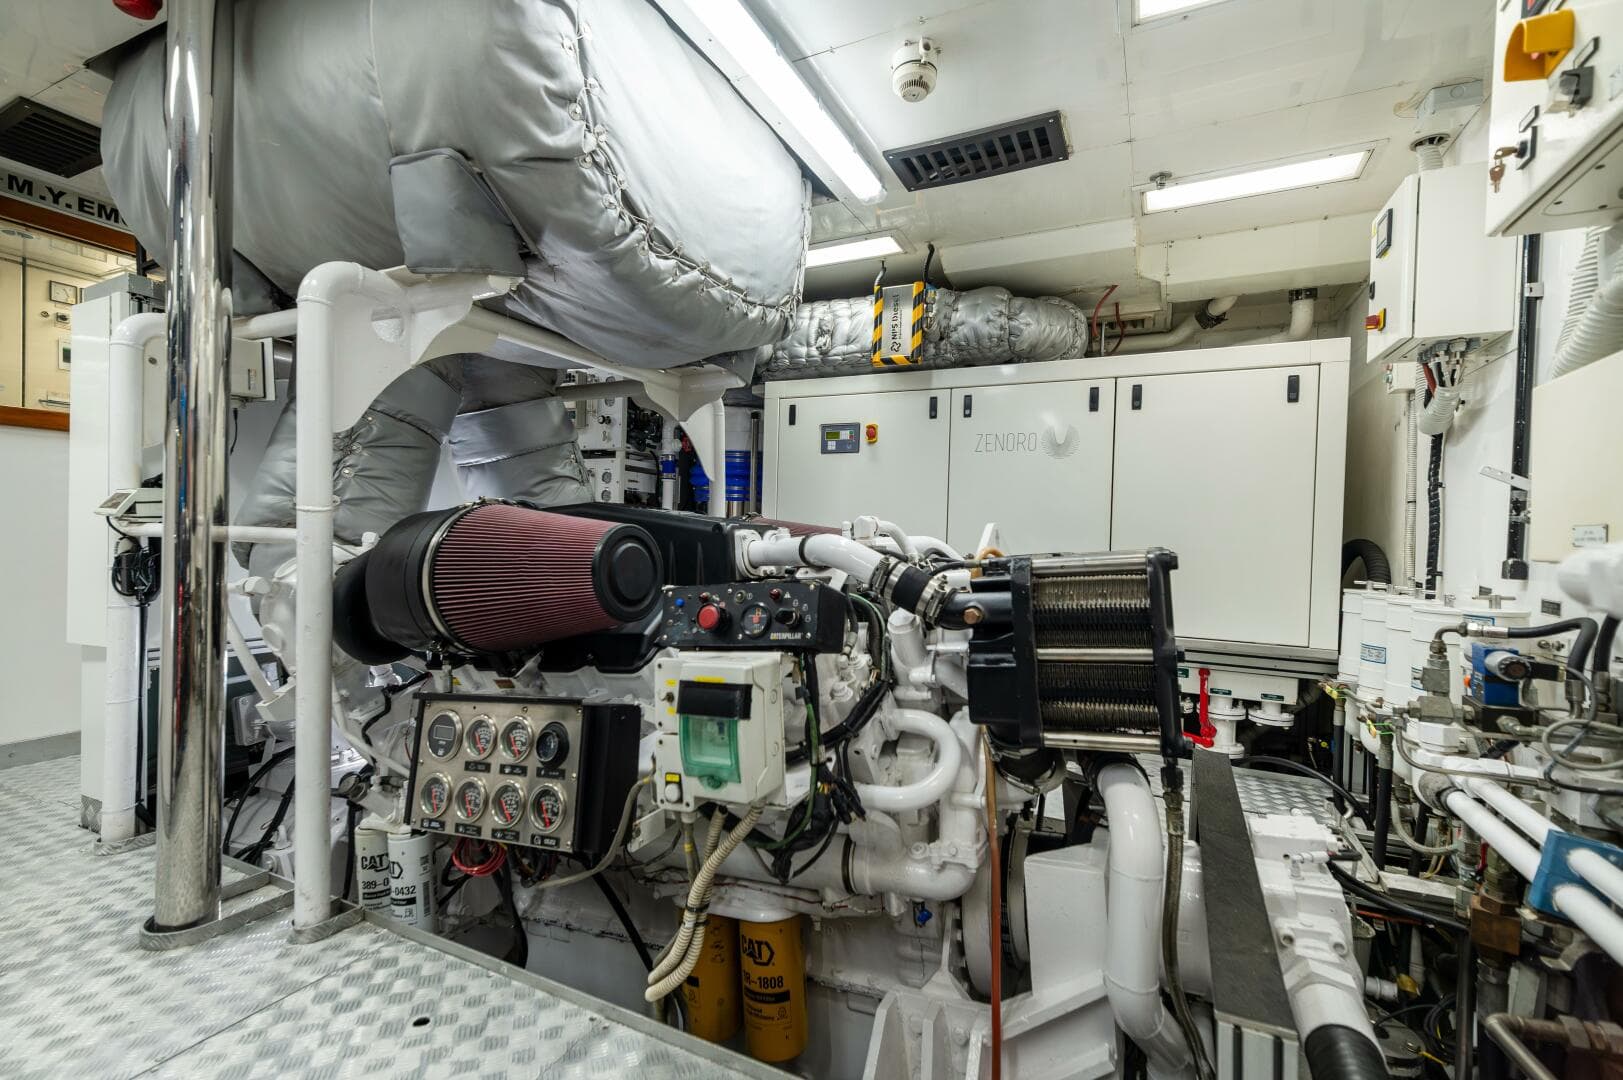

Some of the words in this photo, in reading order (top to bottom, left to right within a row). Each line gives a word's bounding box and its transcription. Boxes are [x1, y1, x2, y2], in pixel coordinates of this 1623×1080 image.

[891, 294, 900, 322] Diesel
[974, 432, 1038, 453] ZENORO
[361, 853, 389, 872] CAT
[741, 934, 769, 964] CAT
